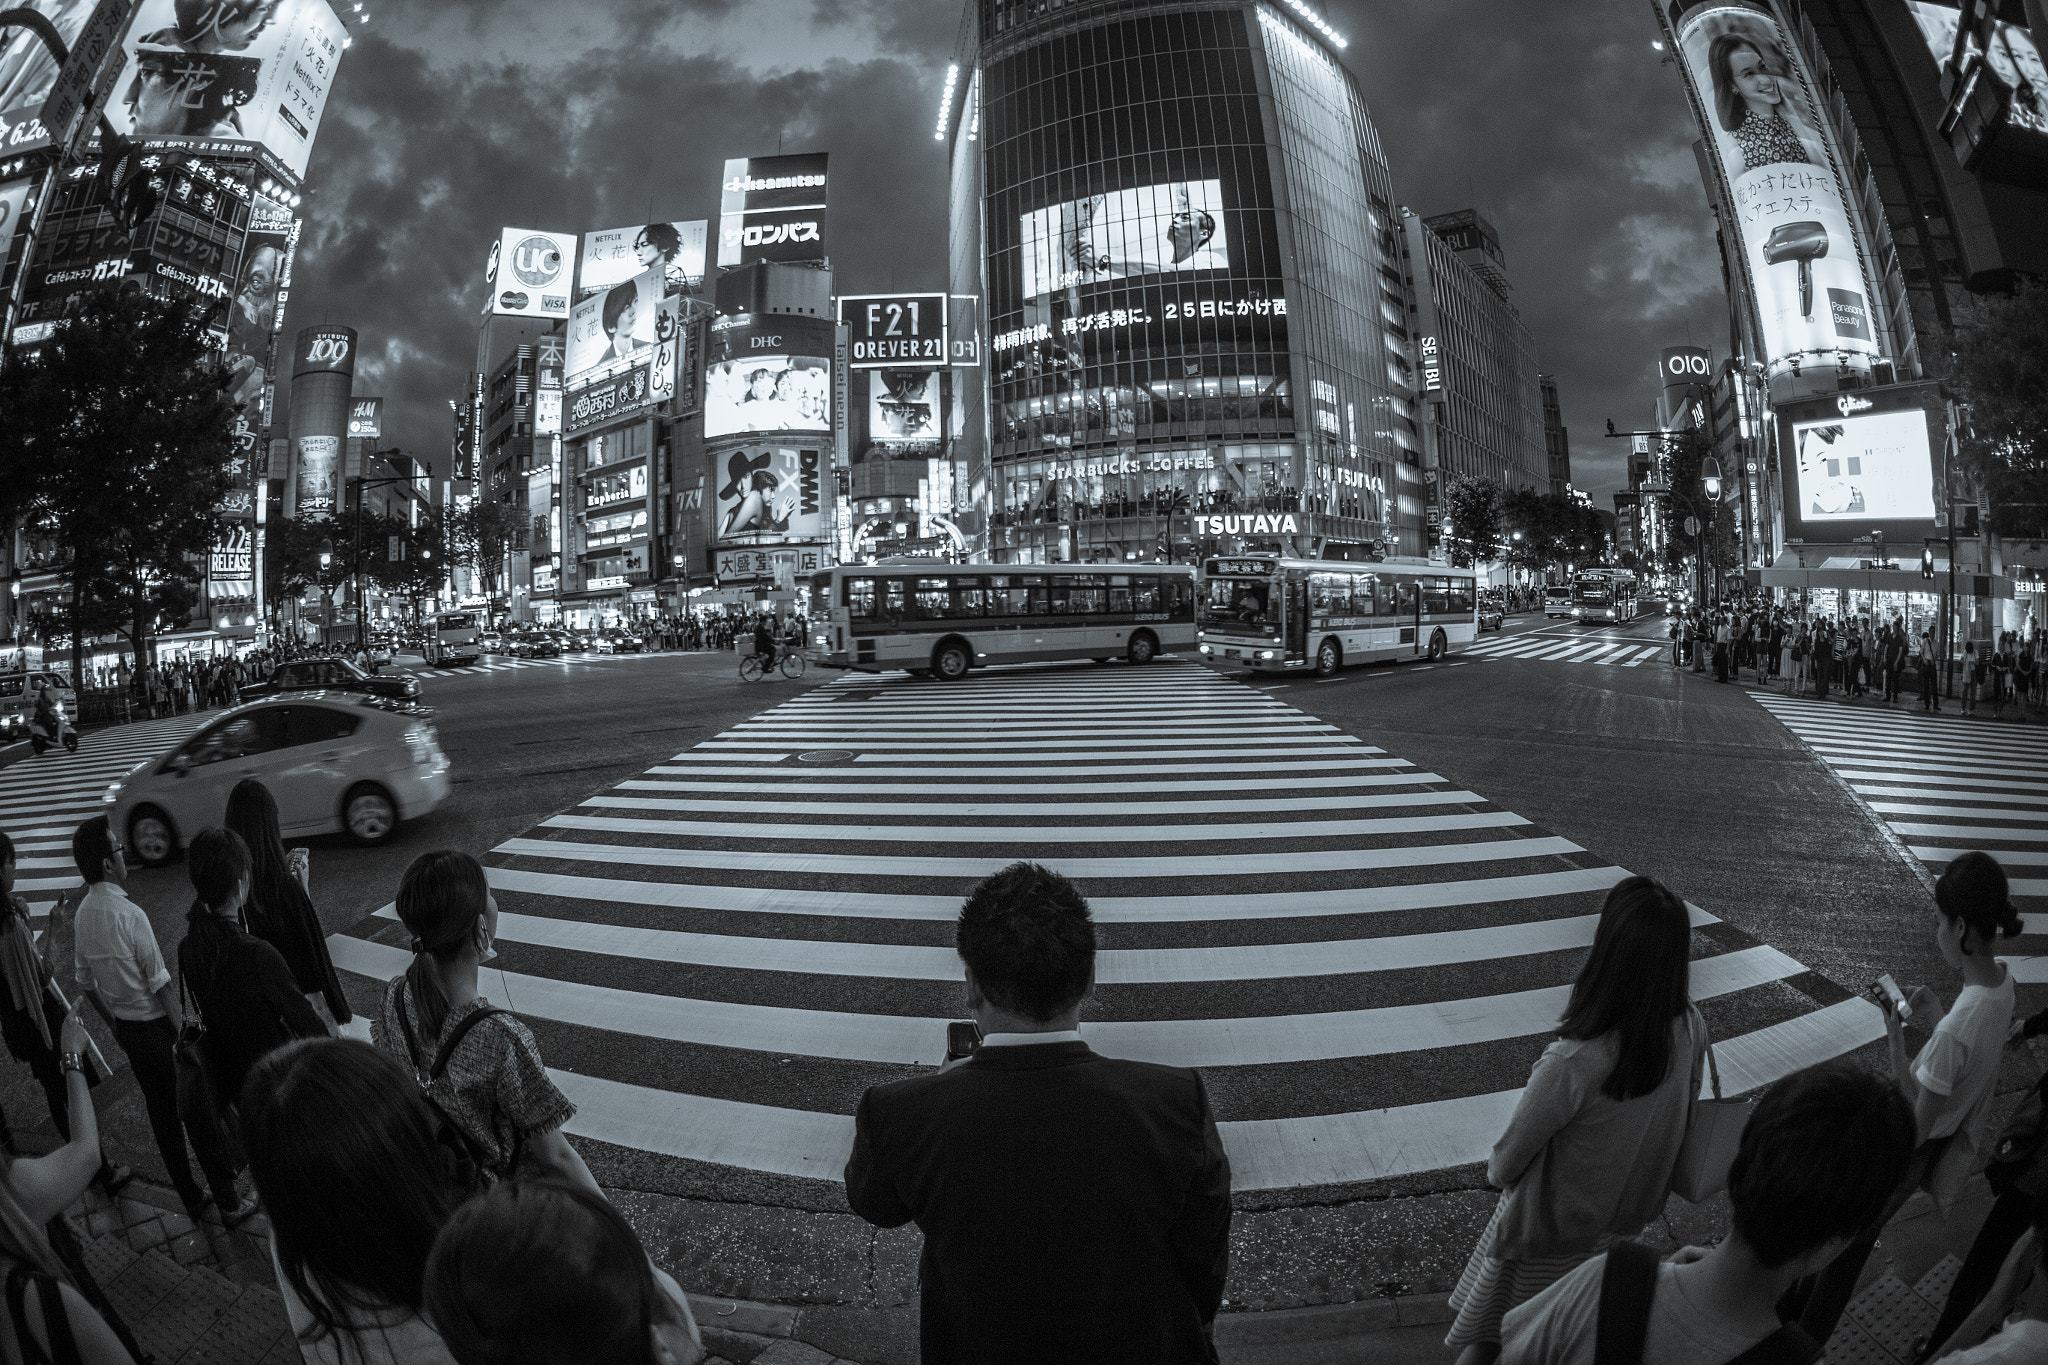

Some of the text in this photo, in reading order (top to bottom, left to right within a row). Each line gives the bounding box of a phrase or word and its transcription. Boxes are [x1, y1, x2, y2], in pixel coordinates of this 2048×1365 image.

[285, 80, 316, 121] ドラマ化
[1736, 171, 1836, 208] 乾かすだけで、
[595, 233, 622, 243] NETFLIX
[724, 222, 820, 248] サロンパス
[589, 244, 627, 262] 火花
[91, 258, 135, 281] ガスト
[195, 273, 229, 300] ガスト
[21, 301, 40, 320] 7F
[544, 300, 567, 309] VISA
[575, 303, 597, 321] NETFLIX
[1831, 301, 1867, 317] Panasonic
[723, 318, 751, 329] Channel
[866, 301, 919, 337] F21
[1833, 312, 1861, 329] Beauty
[317, 333, 349, 341] SHIBUYA
[571, 317, 600, 345] 火花
[750, 335, 783, 349] DHC
[304, 338, 349, 368] 109
[539, 340, 565, 367] 本
[652, 308, 676, 397] もんじゃ
[853, 338, 942, 360] OREVER 21
[1421, 335, 1442, 392] SEIBU
[353, 401, 377, 418] H&M
[360, 425, 378, 433] 150m
[778, 448, 800, 494] FX
[1047, 455, 1215, 482] STARBUCKS COFFEE
[800, 449, 820, 517] DMM
[587, 488, 630, 507] Euphoria
[1193, 513, 1298, 536] TSUTAYA
[211, 553, 252, 572] RELEASE
[720, 552, 818, 576] 大盛堂店
[1152, 612, 1171, 621] BUS
